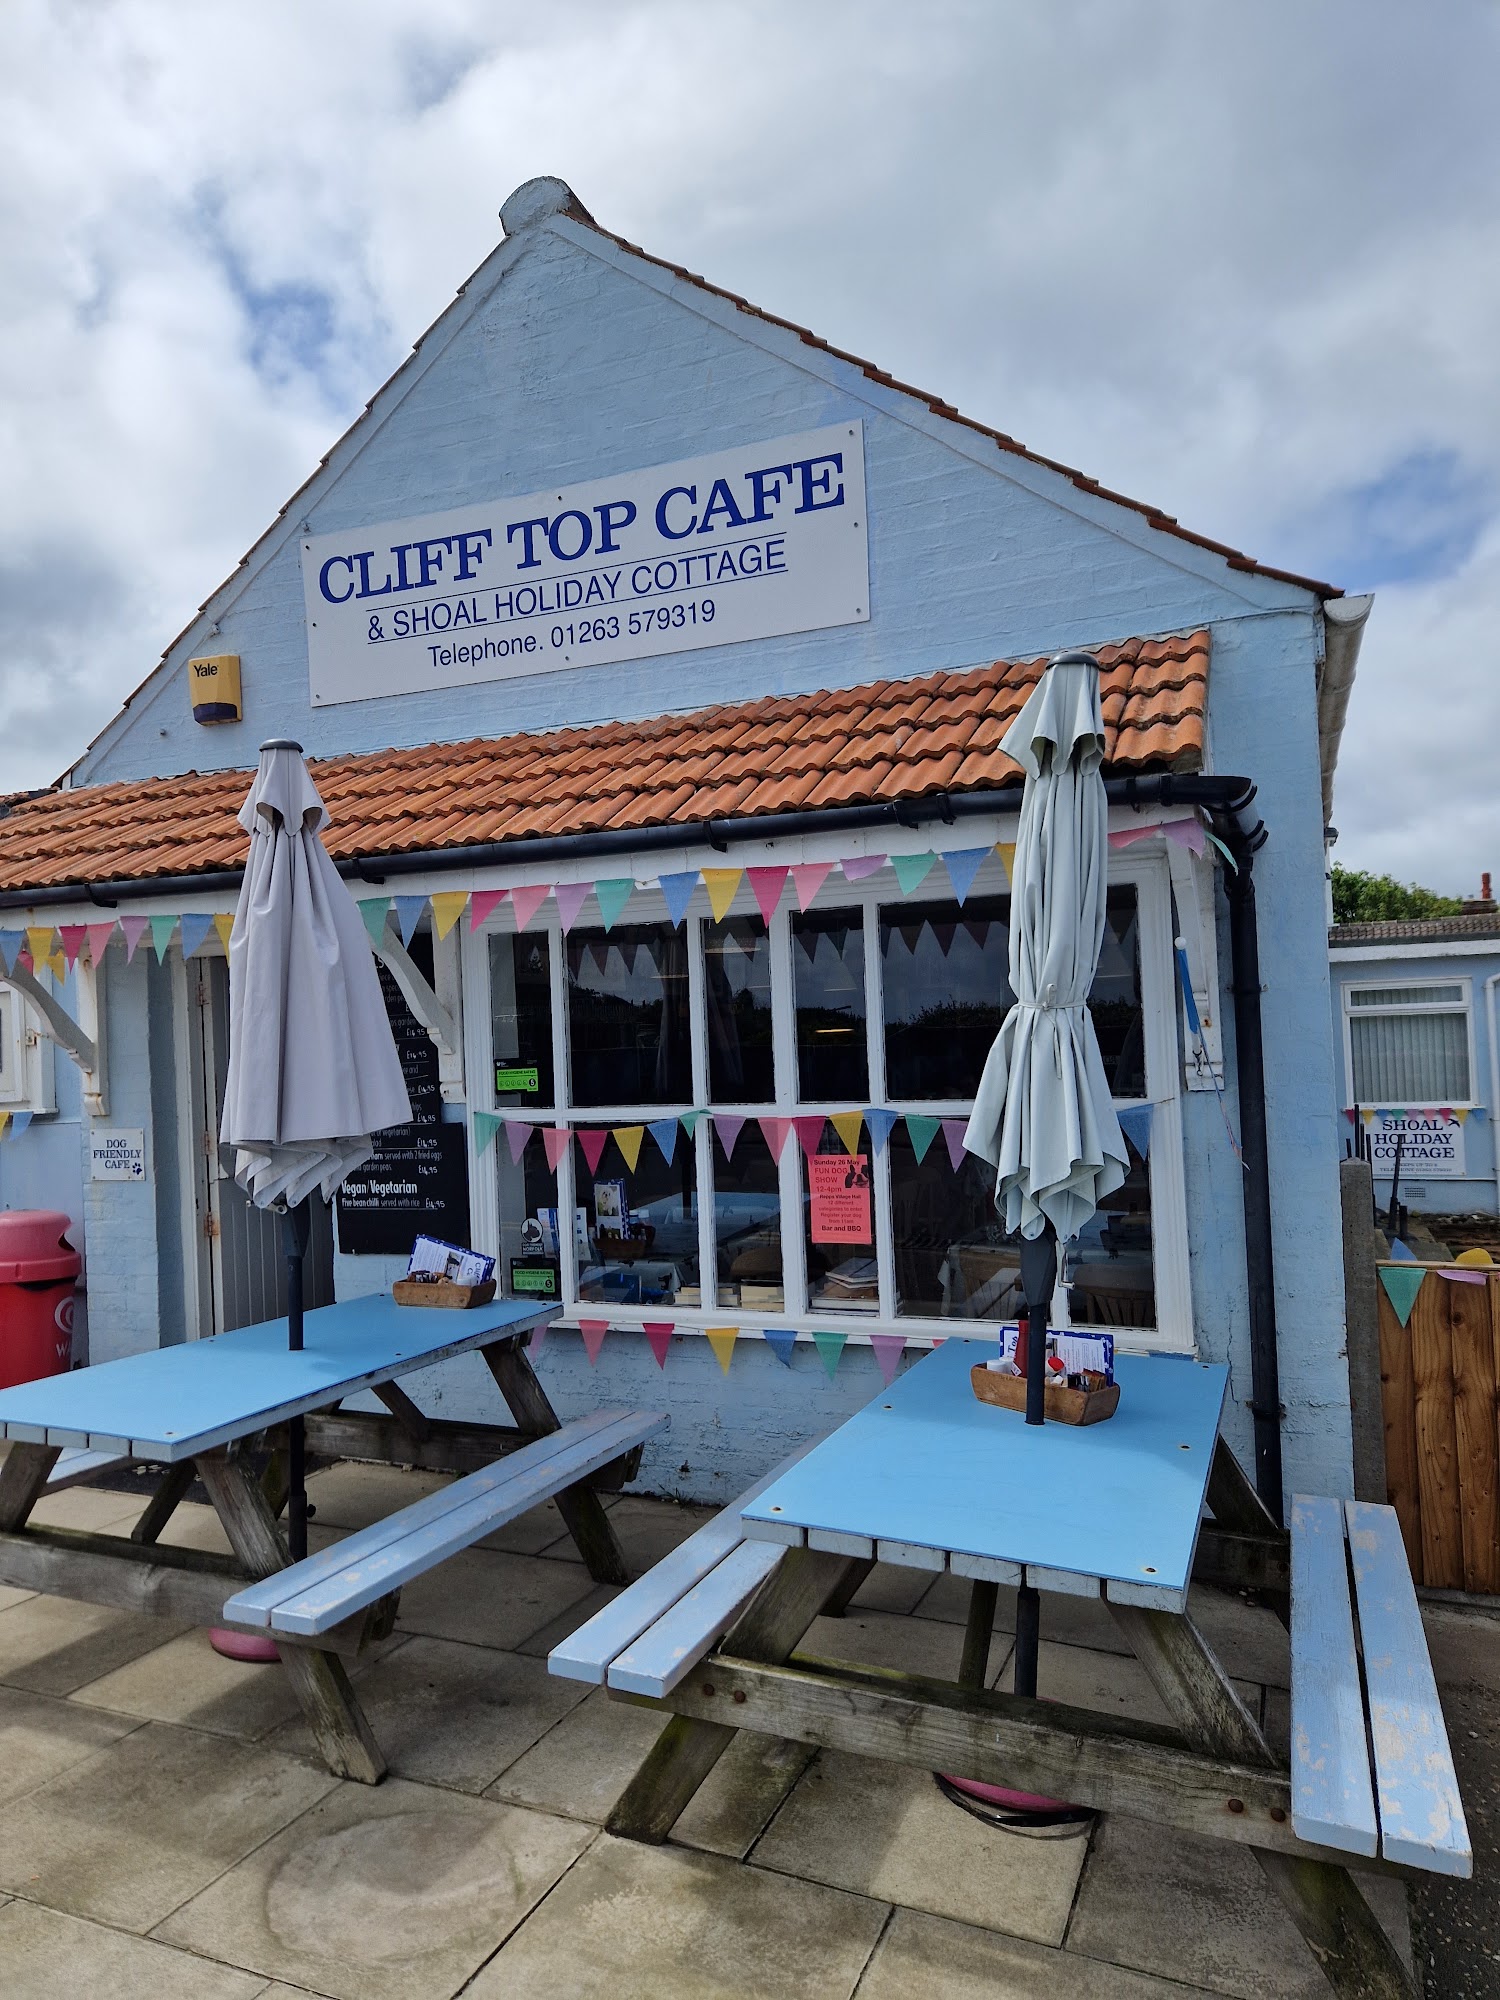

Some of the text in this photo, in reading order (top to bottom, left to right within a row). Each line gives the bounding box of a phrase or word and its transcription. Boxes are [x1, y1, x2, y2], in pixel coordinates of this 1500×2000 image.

[319, 453, 845, 604] CLIFF TOP CAFE
[368, 539, 786, 641] & SHOAL HOLIDAY COTTAGE
[427, 600, 716, 668] Telephone. 01263 579319
[193, 663, 218, 677] Yale
[1382, 1119, 1443, 1131] SHOAL
[106, 1139, 127, 1148] DOG
[1374, 1133, 1453, 1145] HOLIDAY
[93, 1149, 142, 1159] FRIENDLY
[384, 1151, 402, 1160] served
[402, 1151, 414, 1160] with
[418, 1150, 430, 1160] fried
[430, 1152, 443, 1162] eggs
[1374, 1147, 1455, 1158] COTTAGE
[105, 1160, 130, 1169] CAFE
[341, 1197, 352, 1207] Five
[353, 1197, 366, 1207] bean
[366, 1197, 380, 1207] chilli
[380, 1198, 397, 1207] served
[397, 1198, 410, 1207] with
[410, 1198, 421, 1207] rice
